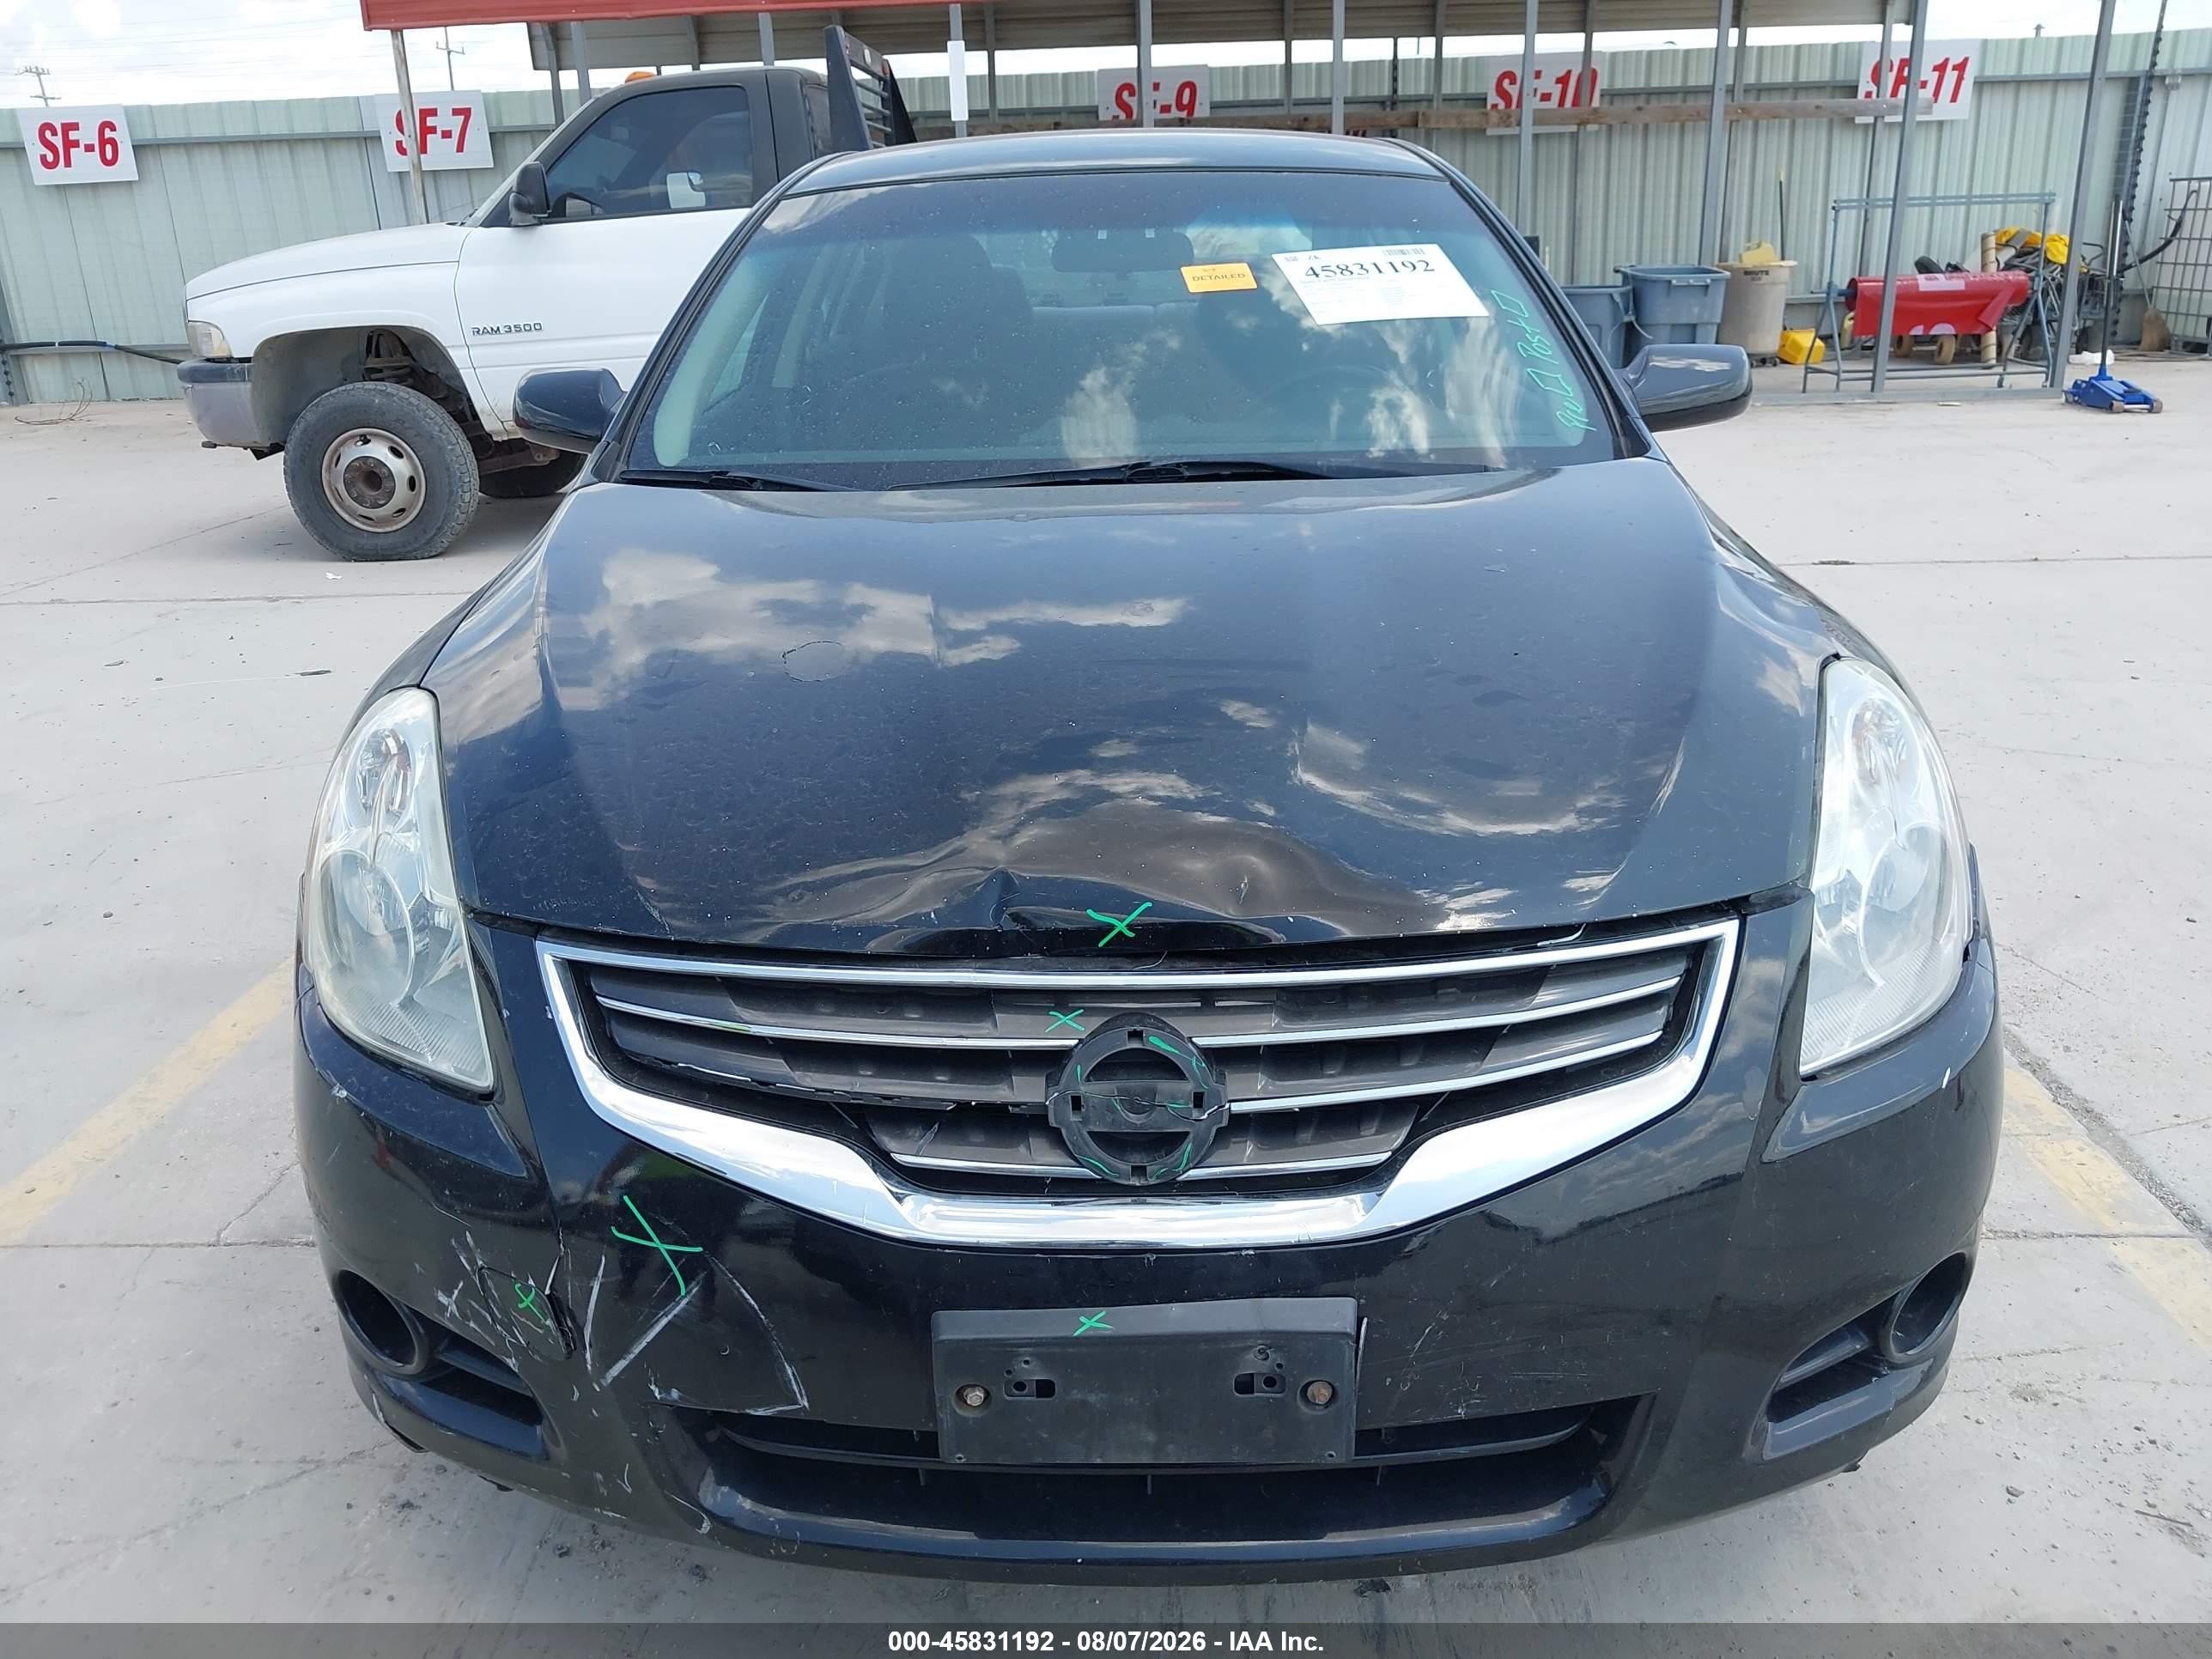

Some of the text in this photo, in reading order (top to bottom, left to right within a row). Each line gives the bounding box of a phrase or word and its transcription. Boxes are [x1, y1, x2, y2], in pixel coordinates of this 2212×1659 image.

[1113, 80, 1197, 119] S-9
[1490, 67, 1599, 110] S-10
[38, 120, 119, 170] SF-6
[1192, 273, 1246, 282] DETAILED
[1304, 259, 1436, 278] 45831192
[471, 322, 543, 336] RAM 3500
[1507, 318, 1559, 364] Post
